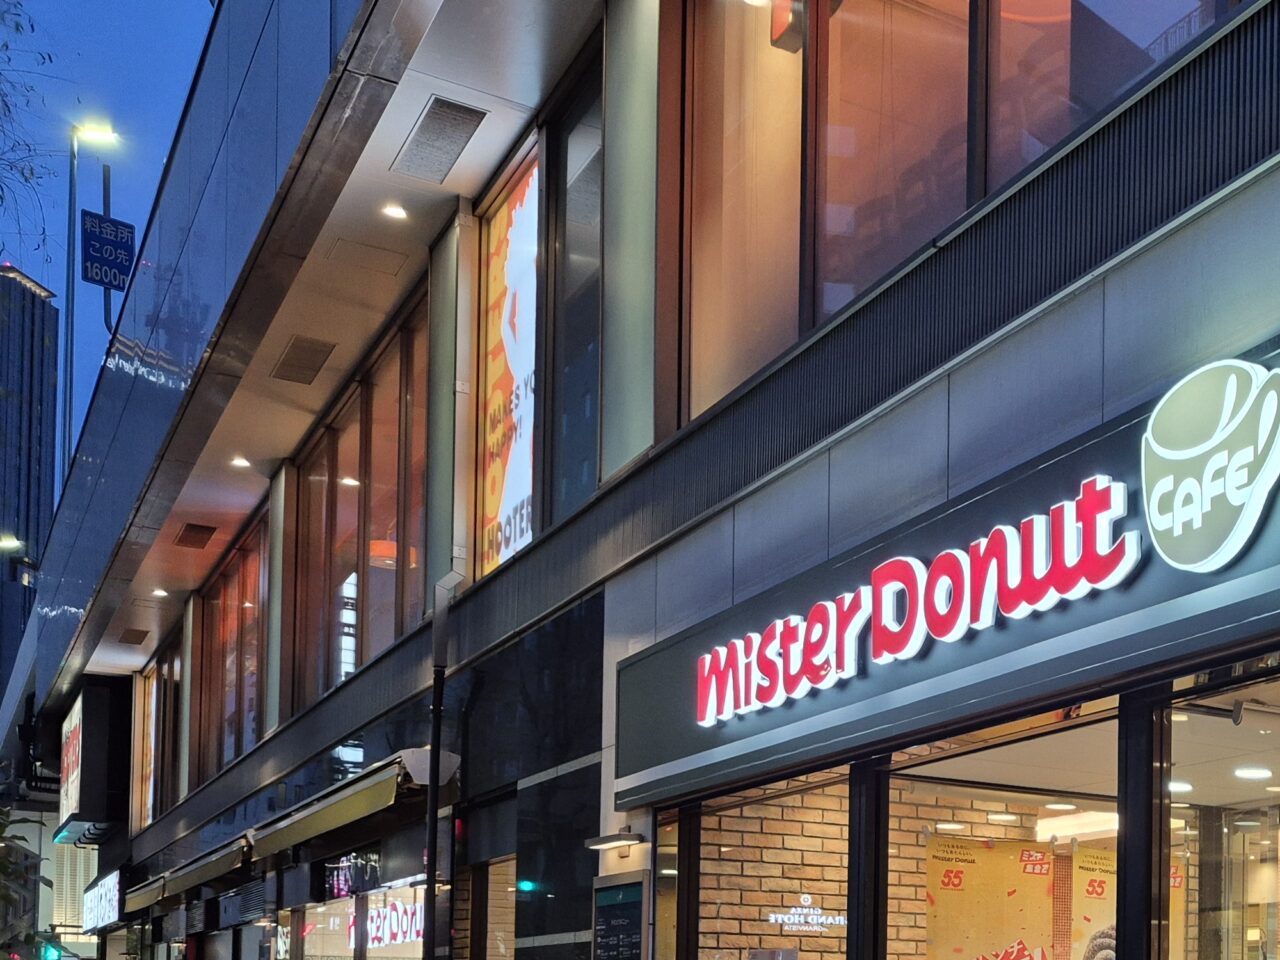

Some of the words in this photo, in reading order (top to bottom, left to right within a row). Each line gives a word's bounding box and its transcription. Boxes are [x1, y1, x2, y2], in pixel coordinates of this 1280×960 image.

[84, 216, 133, 245] 料金所
[89, 241, 129, 266] この先
[1150, 445, 1255, 537] CAFE
[941, 869, 964, 887] 55
[1085, 878, 1106, 896] 55
